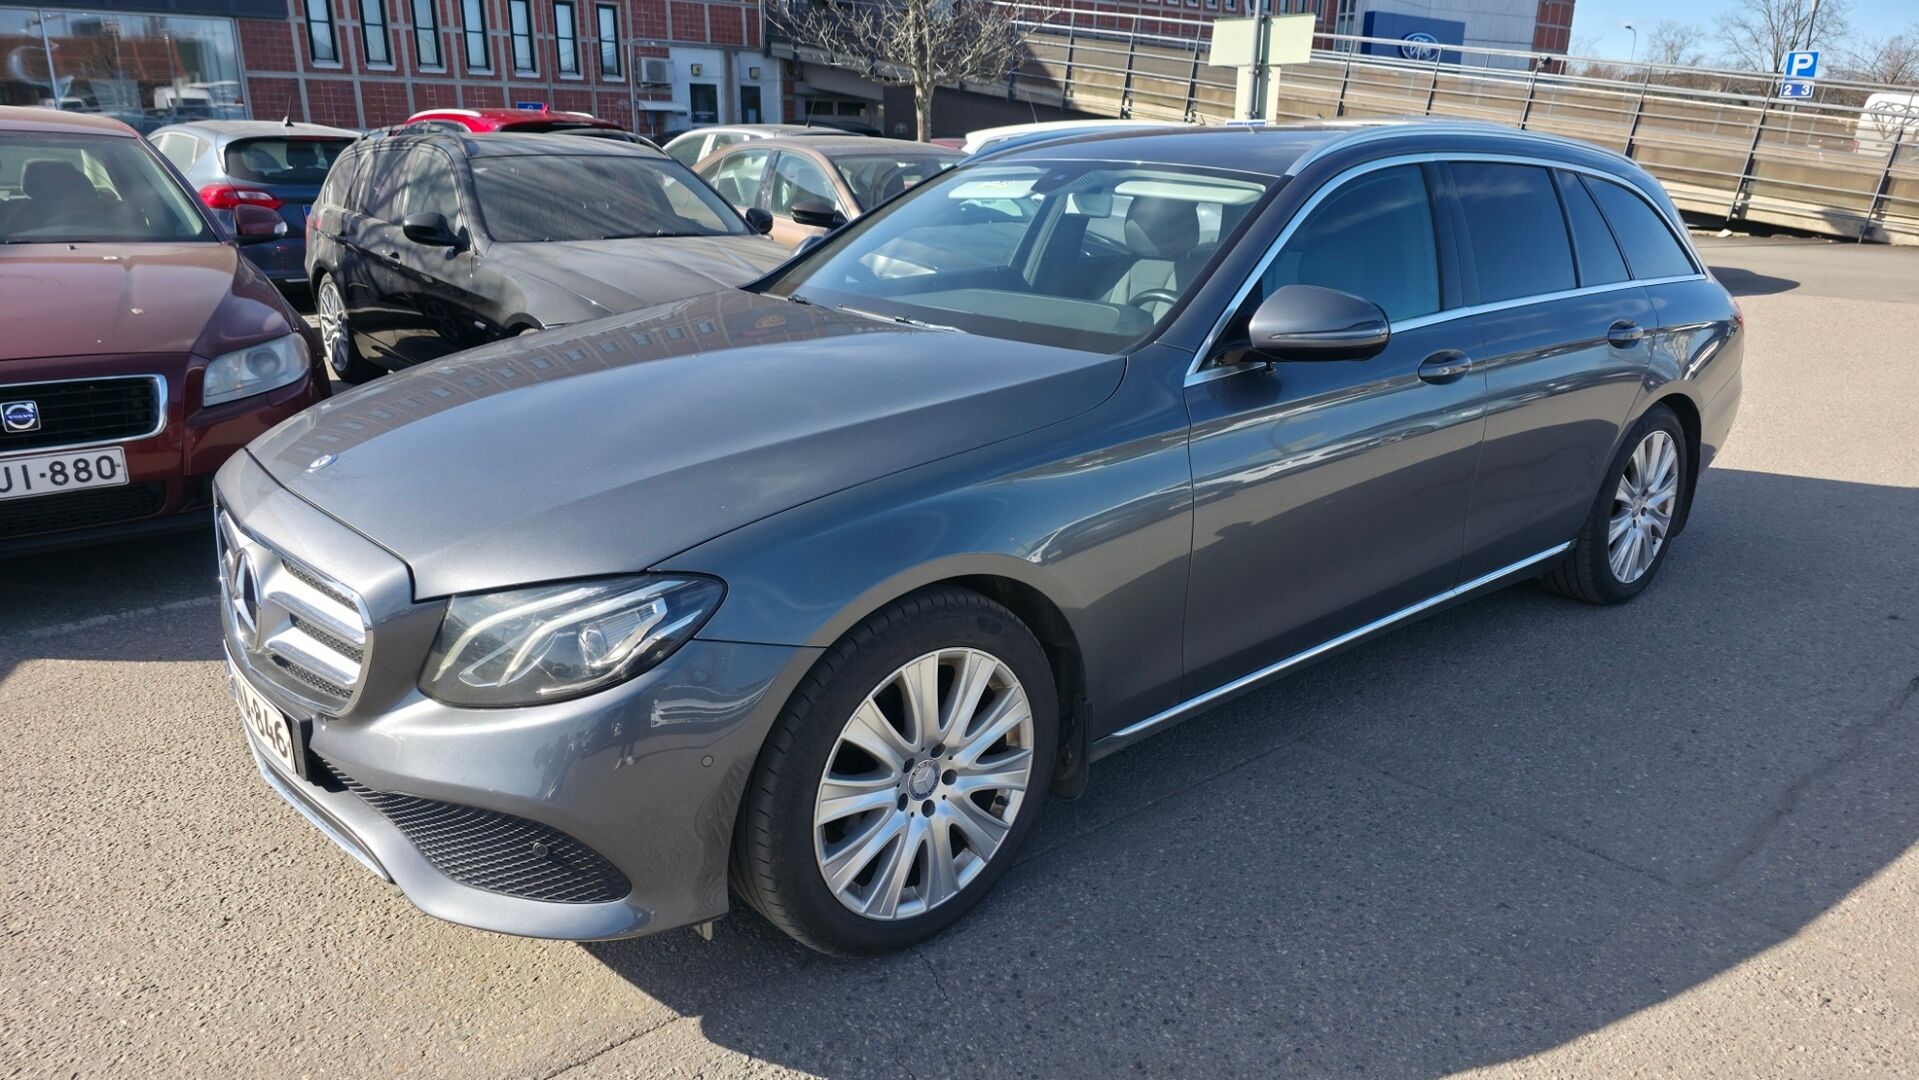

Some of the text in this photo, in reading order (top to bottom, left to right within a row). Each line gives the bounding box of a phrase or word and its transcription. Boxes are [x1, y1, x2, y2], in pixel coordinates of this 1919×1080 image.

[1790, 53, 1814, 76] P
[1783, 84, 1810, 95] 2 3
